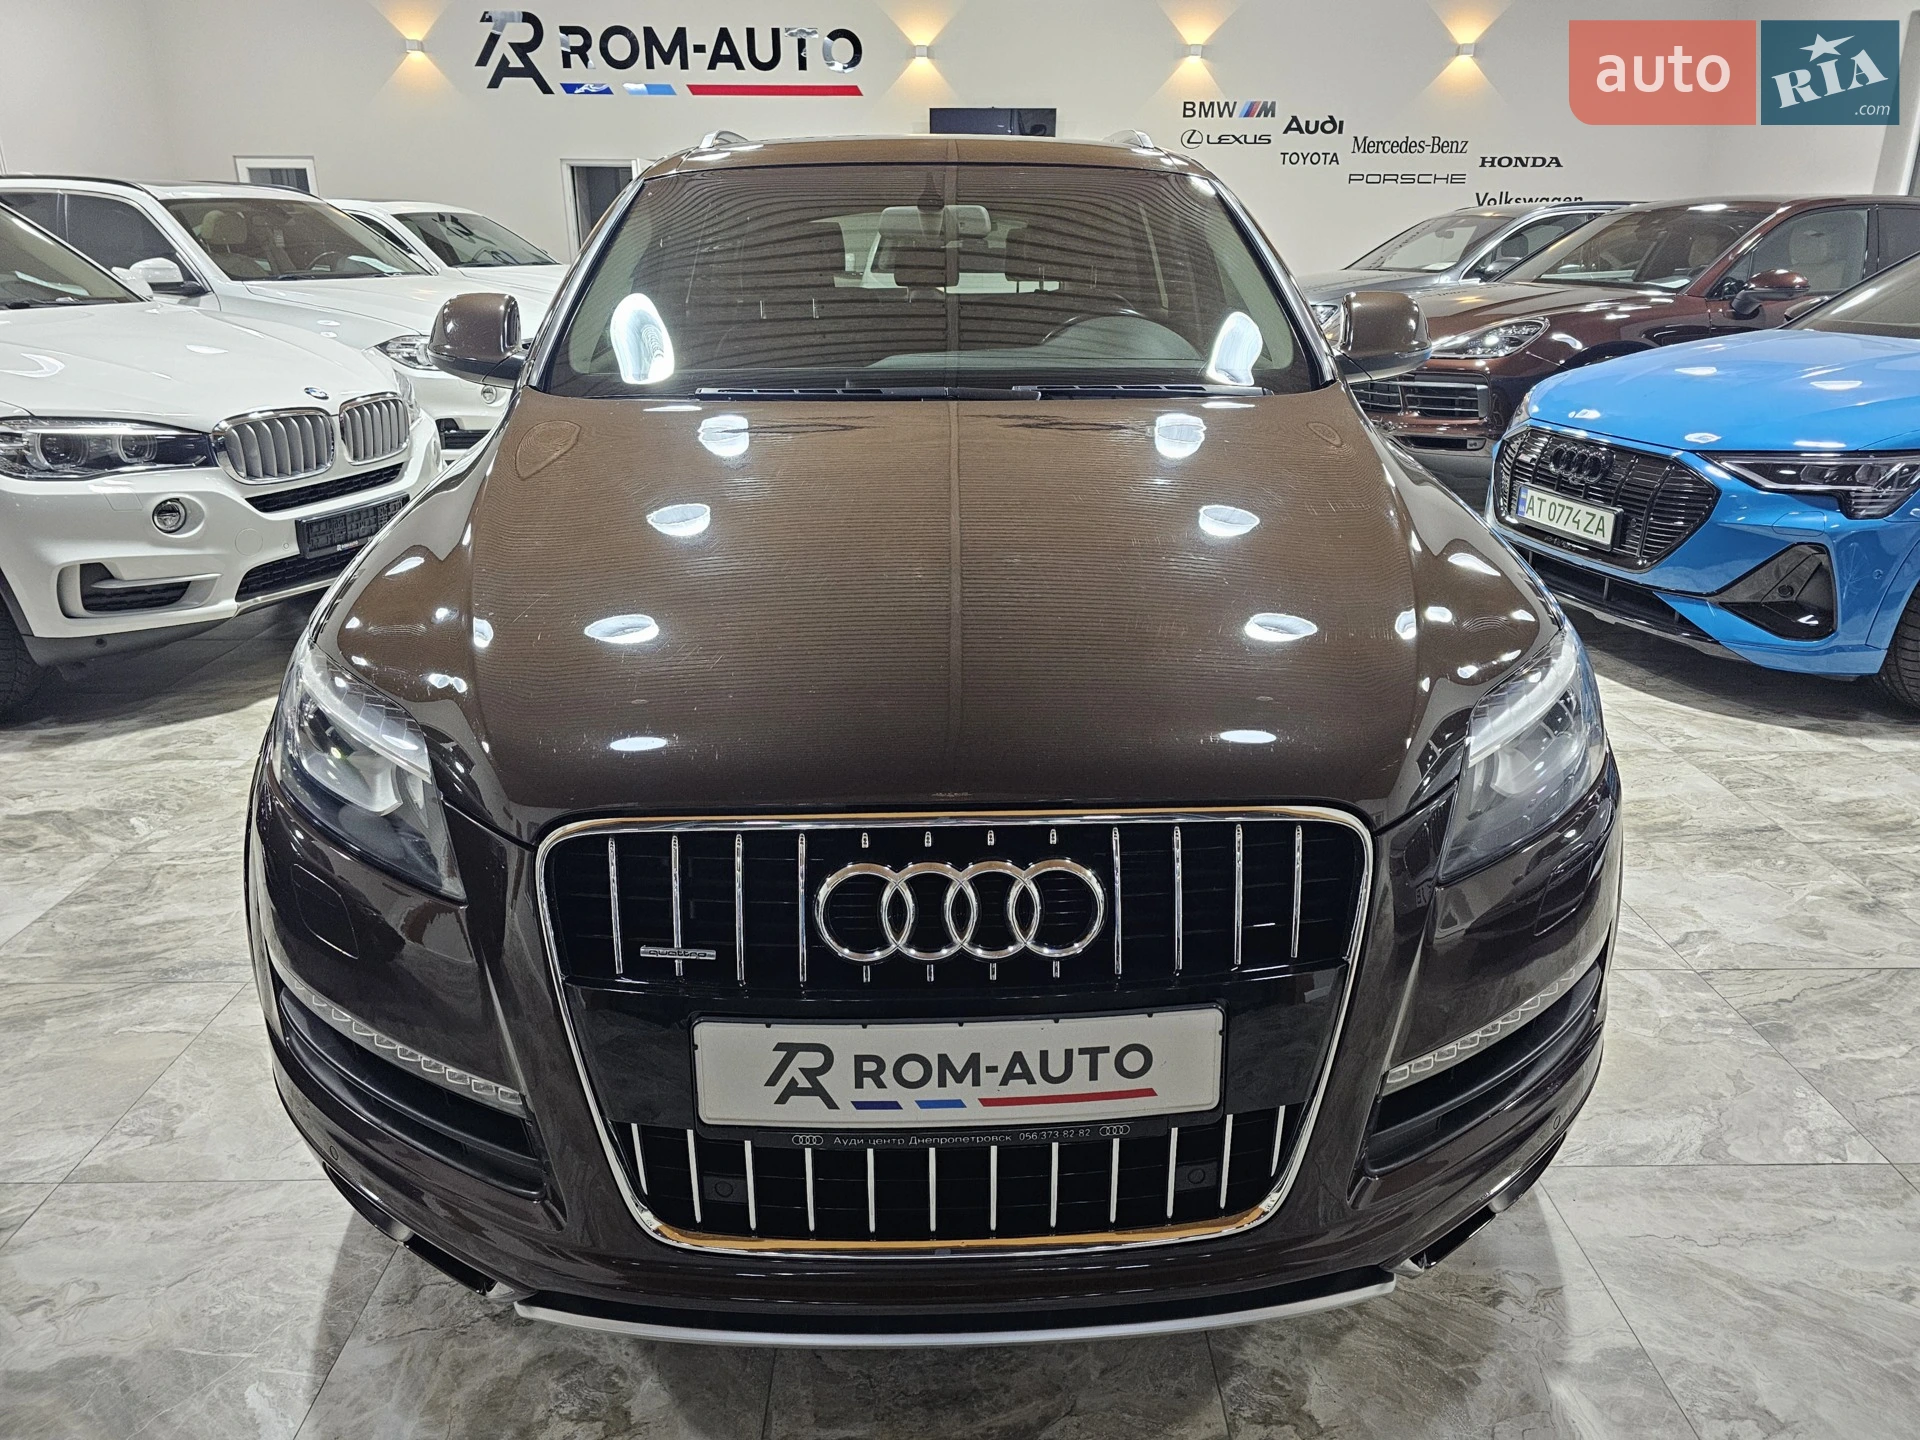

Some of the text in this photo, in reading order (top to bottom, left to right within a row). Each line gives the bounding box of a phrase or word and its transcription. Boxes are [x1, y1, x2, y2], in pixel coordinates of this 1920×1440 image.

[559, 25, 863, 73] ROM-AUTO
[1182, 101, 1237, 118] BMW
[1282, 115, 1344, 135] Audi
[1206, 134, 1272, 145] LEXUS
[1351, 136, 1469, 154] Mercedes-Benz
[1280, 152, 1340, 166] TOYOTA
[1478, 156, 1564, 168] HONDA
[1348, 173, 1467, 185] PORSCHE
[1525, 495, 1606, 538] AT 0774 ZA
[648, 949, 708, 957] quattro
[853, 1043, 1154, 1090] ROM-AUTO
[833, 1136, 864, 1146] Ауди
[868, 1138, 905, 1146] центр
[908, 1135, 1012, 1146] Днепропетровск
